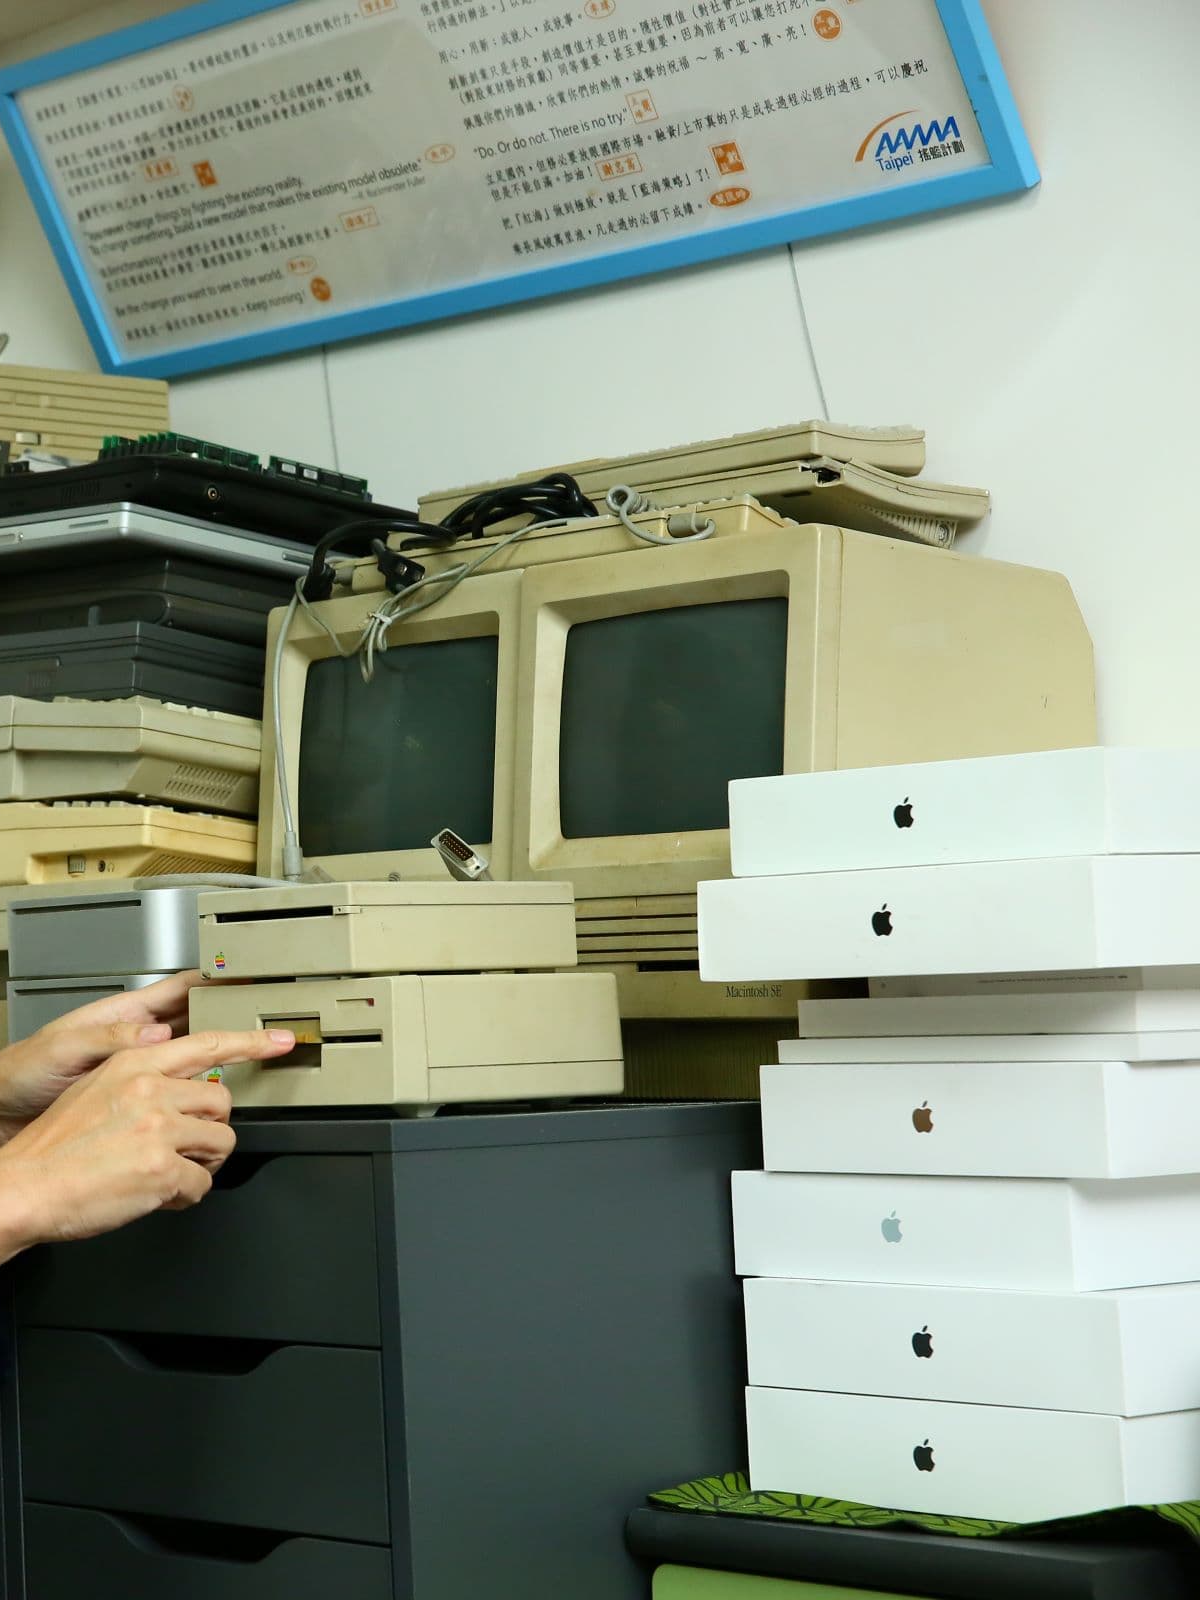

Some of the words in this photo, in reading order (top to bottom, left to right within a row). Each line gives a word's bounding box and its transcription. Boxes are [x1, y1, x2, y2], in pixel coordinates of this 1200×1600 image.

[497, 141, 511, 153] Or
[512, 137, 527, 151] do
[549, 124, 580, 140] There
[581, 120, 591, 132] is
[591, 117, 606, 129] no
[607, 108, 628, 126] try."
[876, 151, 913, 171] Taipei
[918, 140, 965, 162] 搖籃計劃
[202, 215, 220, 226] new
[221, 207, 247, 221] model
[248, 202, 266, 214] that
[267, 195, 296, 208] makes
[296, 190, 312, 201] the
[312, 182, 347, 199] existing
[348, 171, 377, 188] model
[225, 192, 240, 202] the
[242, 184, 275, 199] existing
[171, 294, 186, 307] you
[187, 287, 206, 299] want
[207, 286, 217, 296] to
[218, 282, 232, 294] see
[232, 279, 242, 290] in
[242, 275, 256, 287] the
[726, 984, 768, 998] Macintosh
[771, 984, 782, 997] SE
